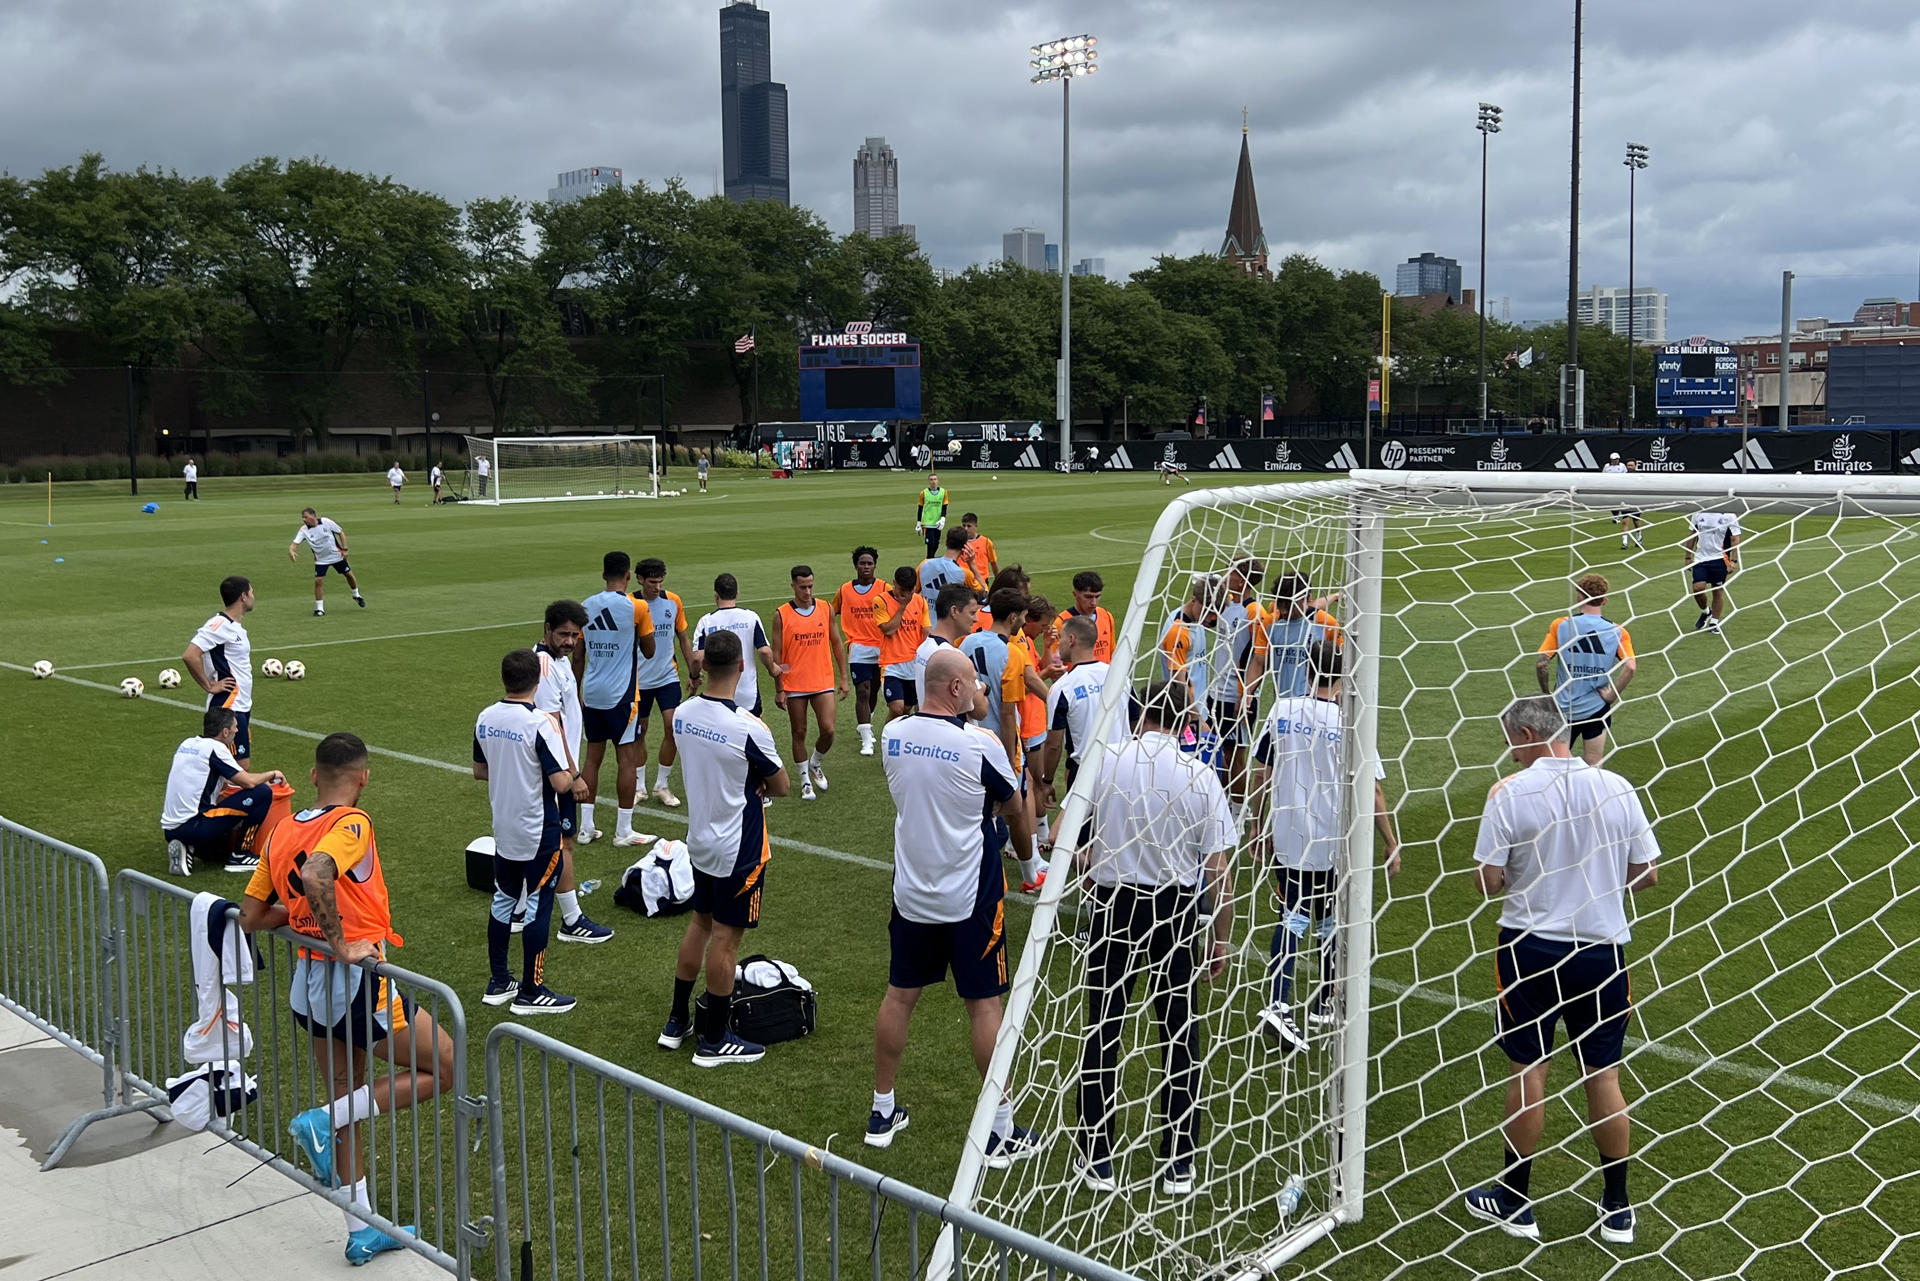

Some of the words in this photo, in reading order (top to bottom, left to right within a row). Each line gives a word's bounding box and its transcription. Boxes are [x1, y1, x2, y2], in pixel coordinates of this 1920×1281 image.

[846, 322, 872, 334] UIC
[811, 334, 858, 346] FLAMES
[860, 333, 907, 345] SOCCER
[1665, 346, 1679, 354] LES
[1680, 346, 1708, 354] MILLER
[1709, 346, 1729, 354] FIELD
[1659, 361, 1681, 372] xfinity
[981, 424, 998, 441] THIS
[999, 424, 1007, 441] IS
[1382, 440, 1406, 469] hp
[1408, 447, 1456, 455] PRESENTING
[843, 460, 867, 468] Emirates
[971, 460, 999, 469] Emirates
[1264, 461, 1302, 471] Emirates
[1476, 460, 1522, 471] Emirates
[1635, 460, 1685, 472] Emirates
[1814, 459, 1873, 472] Emirates
[487, 726, 524, 742] Sanitas
[684, 722, 728, 744] Sanitas
[903, 741, 960, 762] Sanitas
